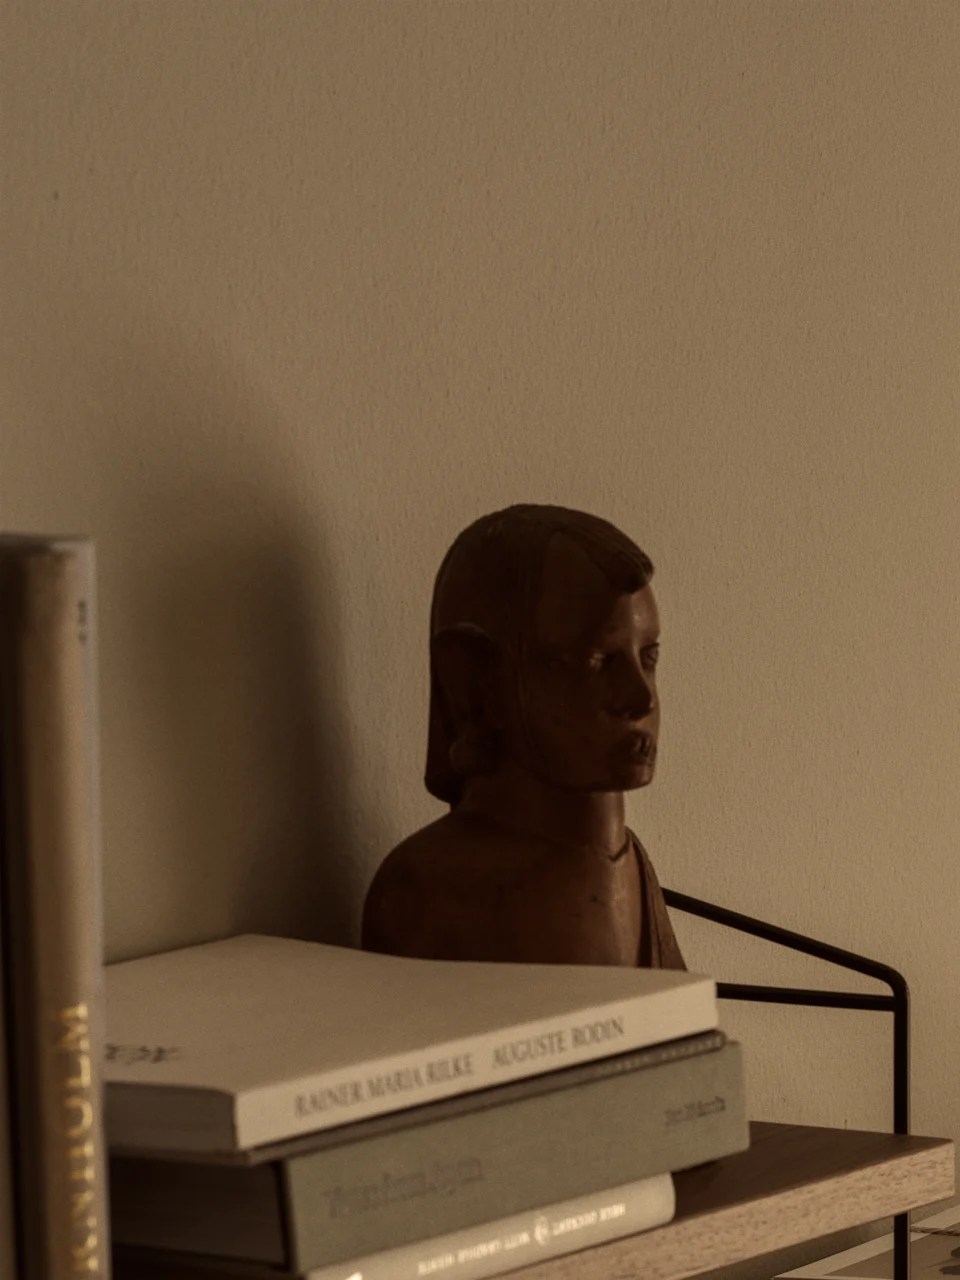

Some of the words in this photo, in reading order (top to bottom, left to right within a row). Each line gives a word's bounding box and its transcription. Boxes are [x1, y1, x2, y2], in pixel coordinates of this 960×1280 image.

[493, 1029, 567, 1069] AUGUSTE
[572, 1016, 625, 1049] RODIN
[366, 1066, 424, 1099] MARIA
